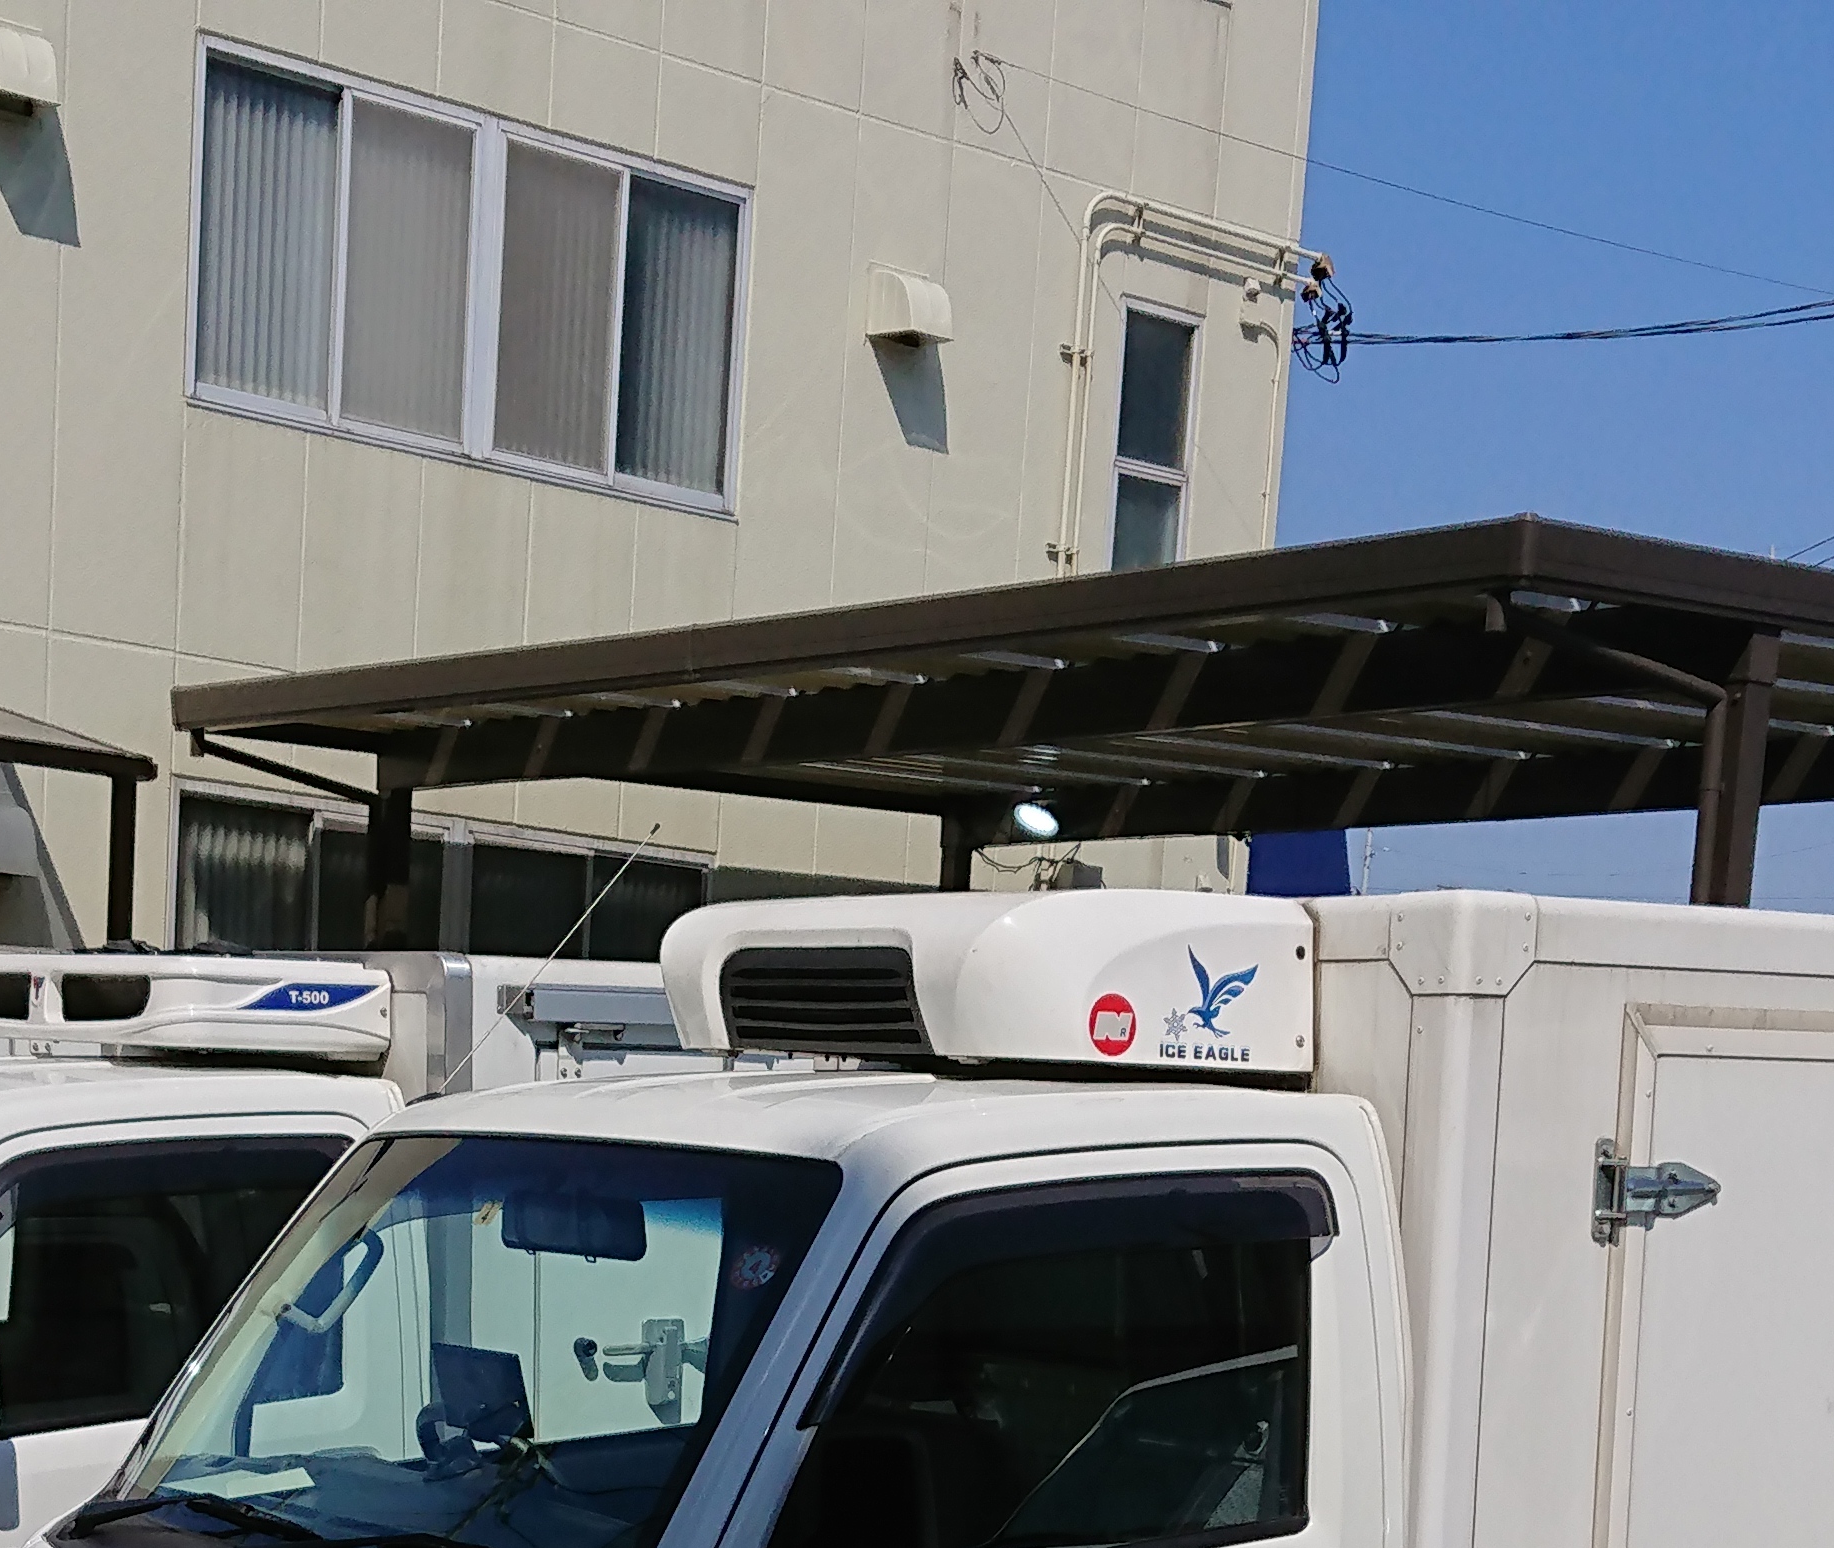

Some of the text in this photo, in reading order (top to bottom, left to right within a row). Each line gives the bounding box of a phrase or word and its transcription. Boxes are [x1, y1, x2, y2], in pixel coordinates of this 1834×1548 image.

[288, 990, 330, 1005] T-500
[1159, 1042, 1251, 1063] ICE EAGLE
